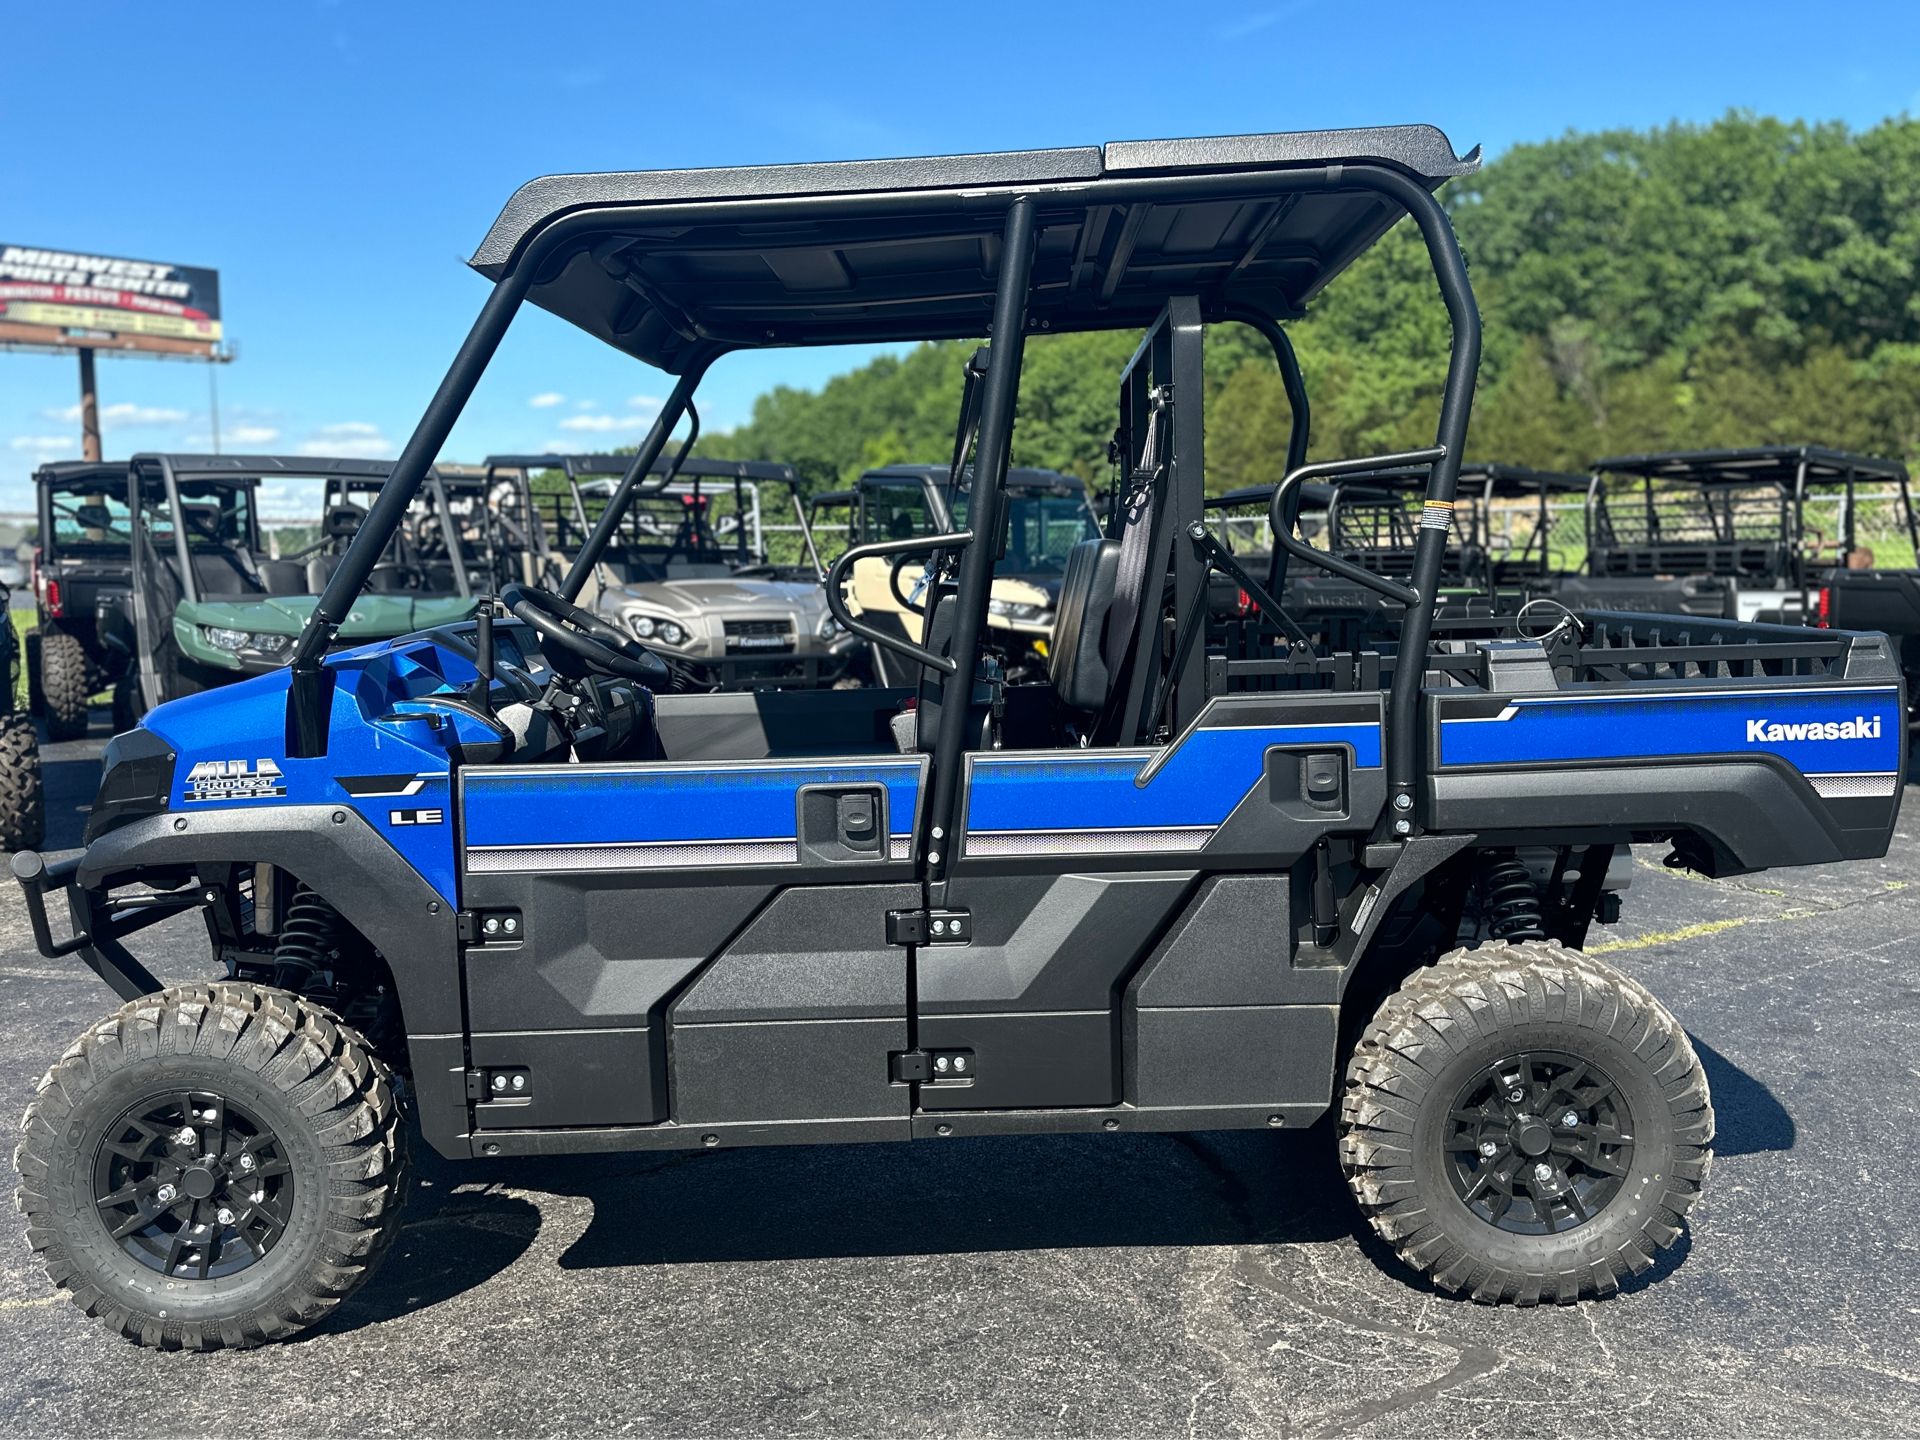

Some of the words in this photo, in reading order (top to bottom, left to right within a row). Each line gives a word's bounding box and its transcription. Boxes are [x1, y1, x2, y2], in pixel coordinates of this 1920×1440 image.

[3, 247, 175, 280] MIDWEST
[91, 273, 190, 298] CENTER
[1746, 715, 1881, 742] Kawasaki
[390, 809, 443, 825] LE
